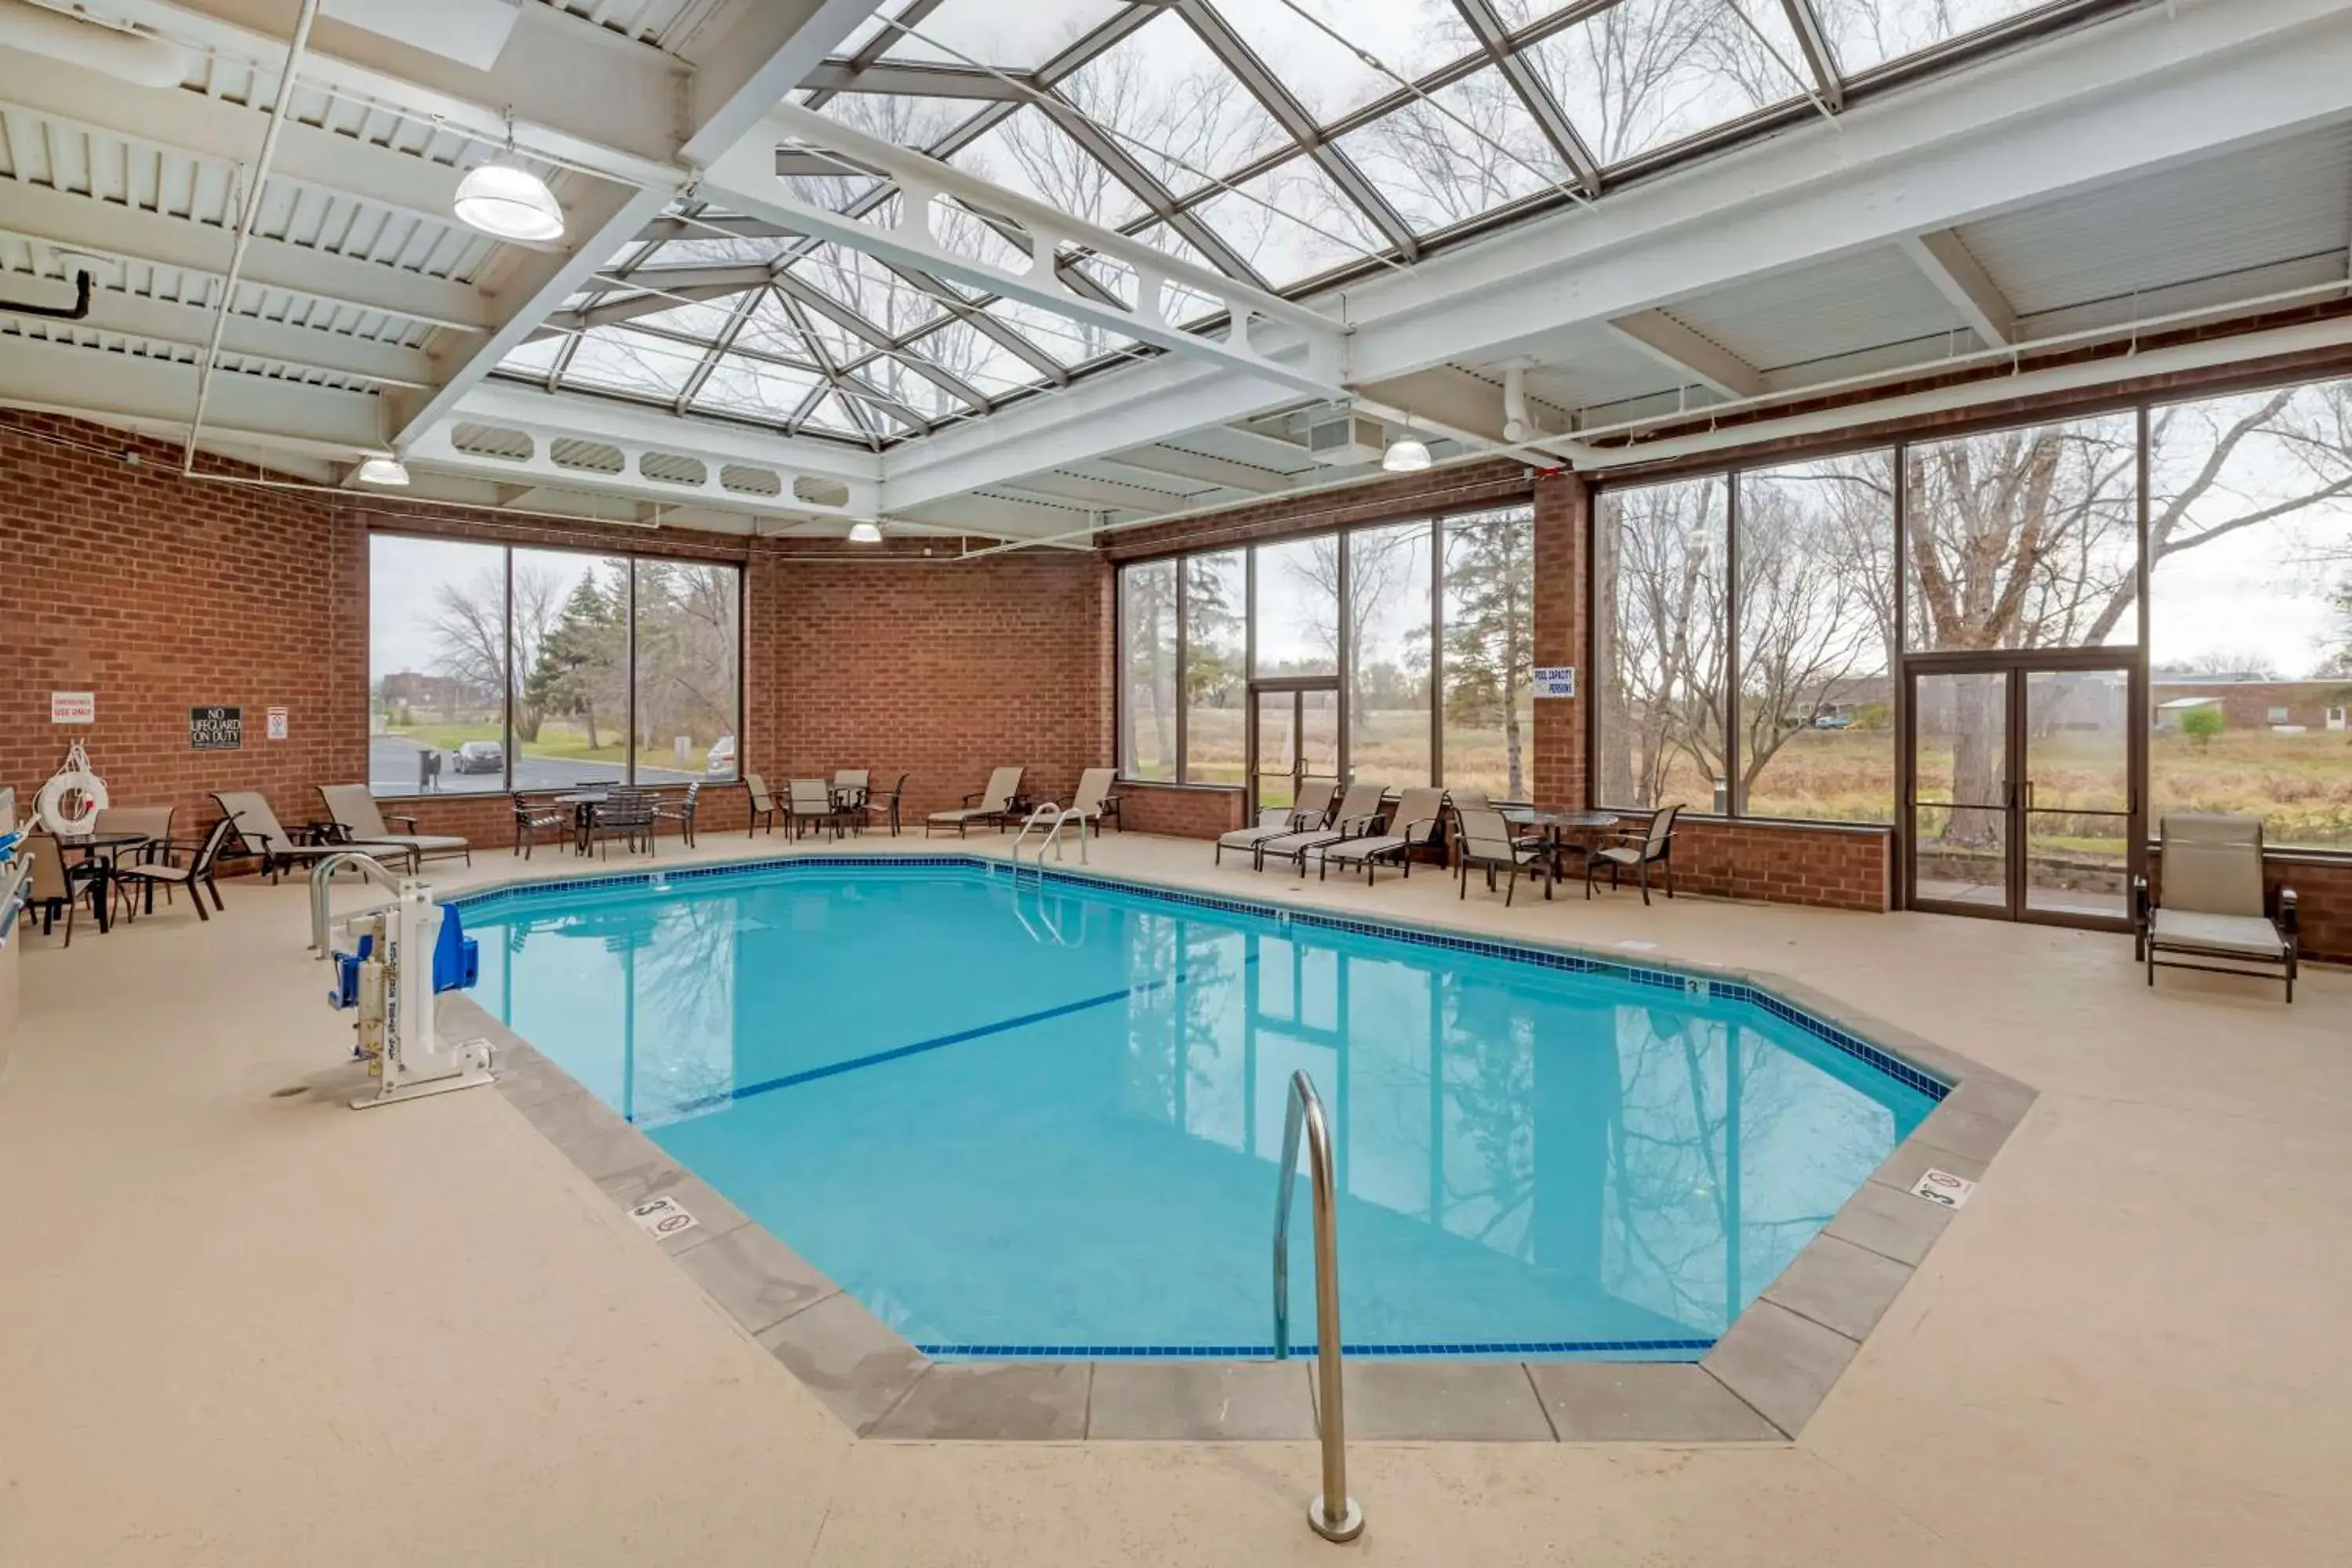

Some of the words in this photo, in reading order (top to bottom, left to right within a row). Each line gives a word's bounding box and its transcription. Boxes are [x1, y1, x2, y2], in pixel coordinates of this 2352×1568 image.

[208, 708, 225, 719] NO
[191, 719, 241, 731] LIFEGUARD
[194, 731, 209, 742] ON
[212, 730, 238, 742] DUTY
[1920, 1189, 1955, 1205] 3
[633, 1200, 667, 1216] 3
